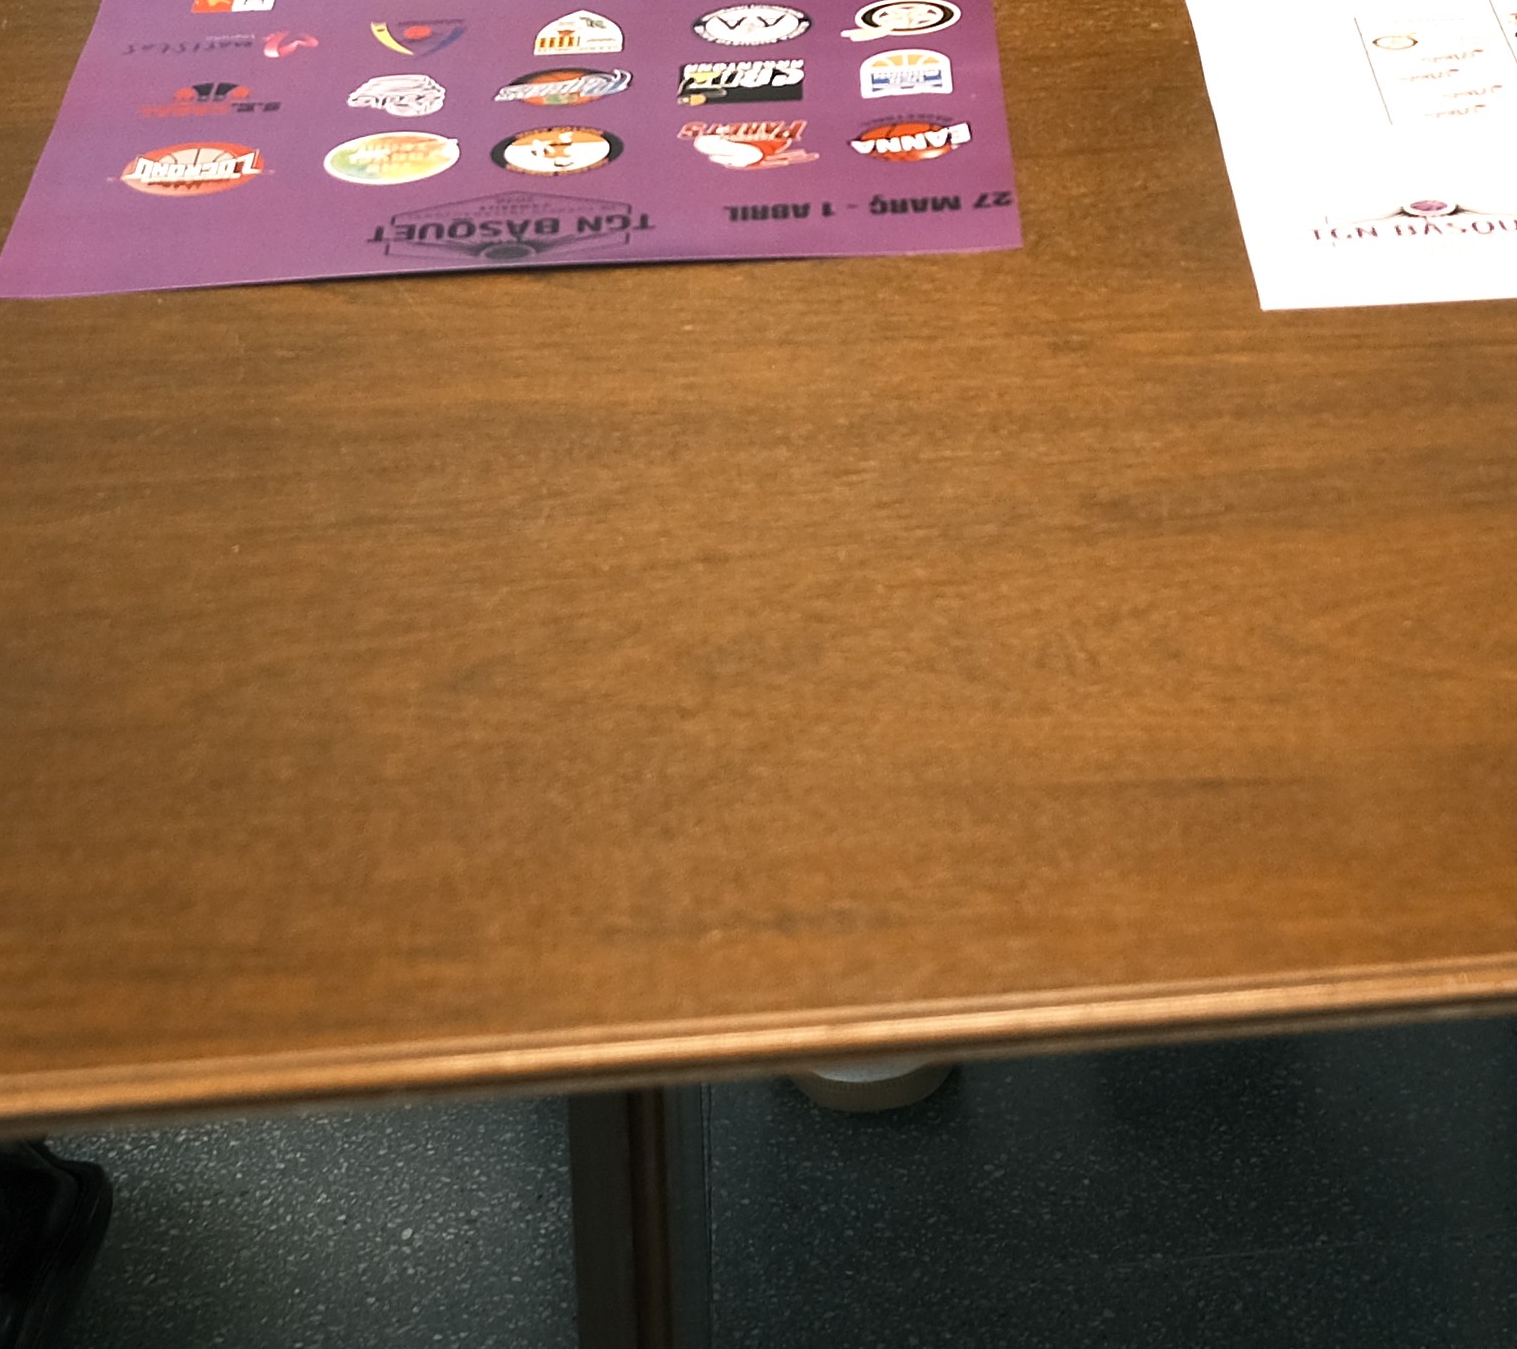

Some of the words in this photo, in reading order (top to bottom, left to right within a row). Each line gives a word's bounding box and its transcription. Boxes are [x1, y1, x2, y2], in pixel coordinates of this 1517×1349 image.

[847, 120, 973, 158] EANNA
[819, 200, 836, 219] 1
[868, 192, 962, 217] MARÇ
[971, 190, 1014, 211] 27
[577, 211, 658, 234] TGN
[724, 202, 811, 224] ABRIL
[1312, 226, 1380, 241] TGN
